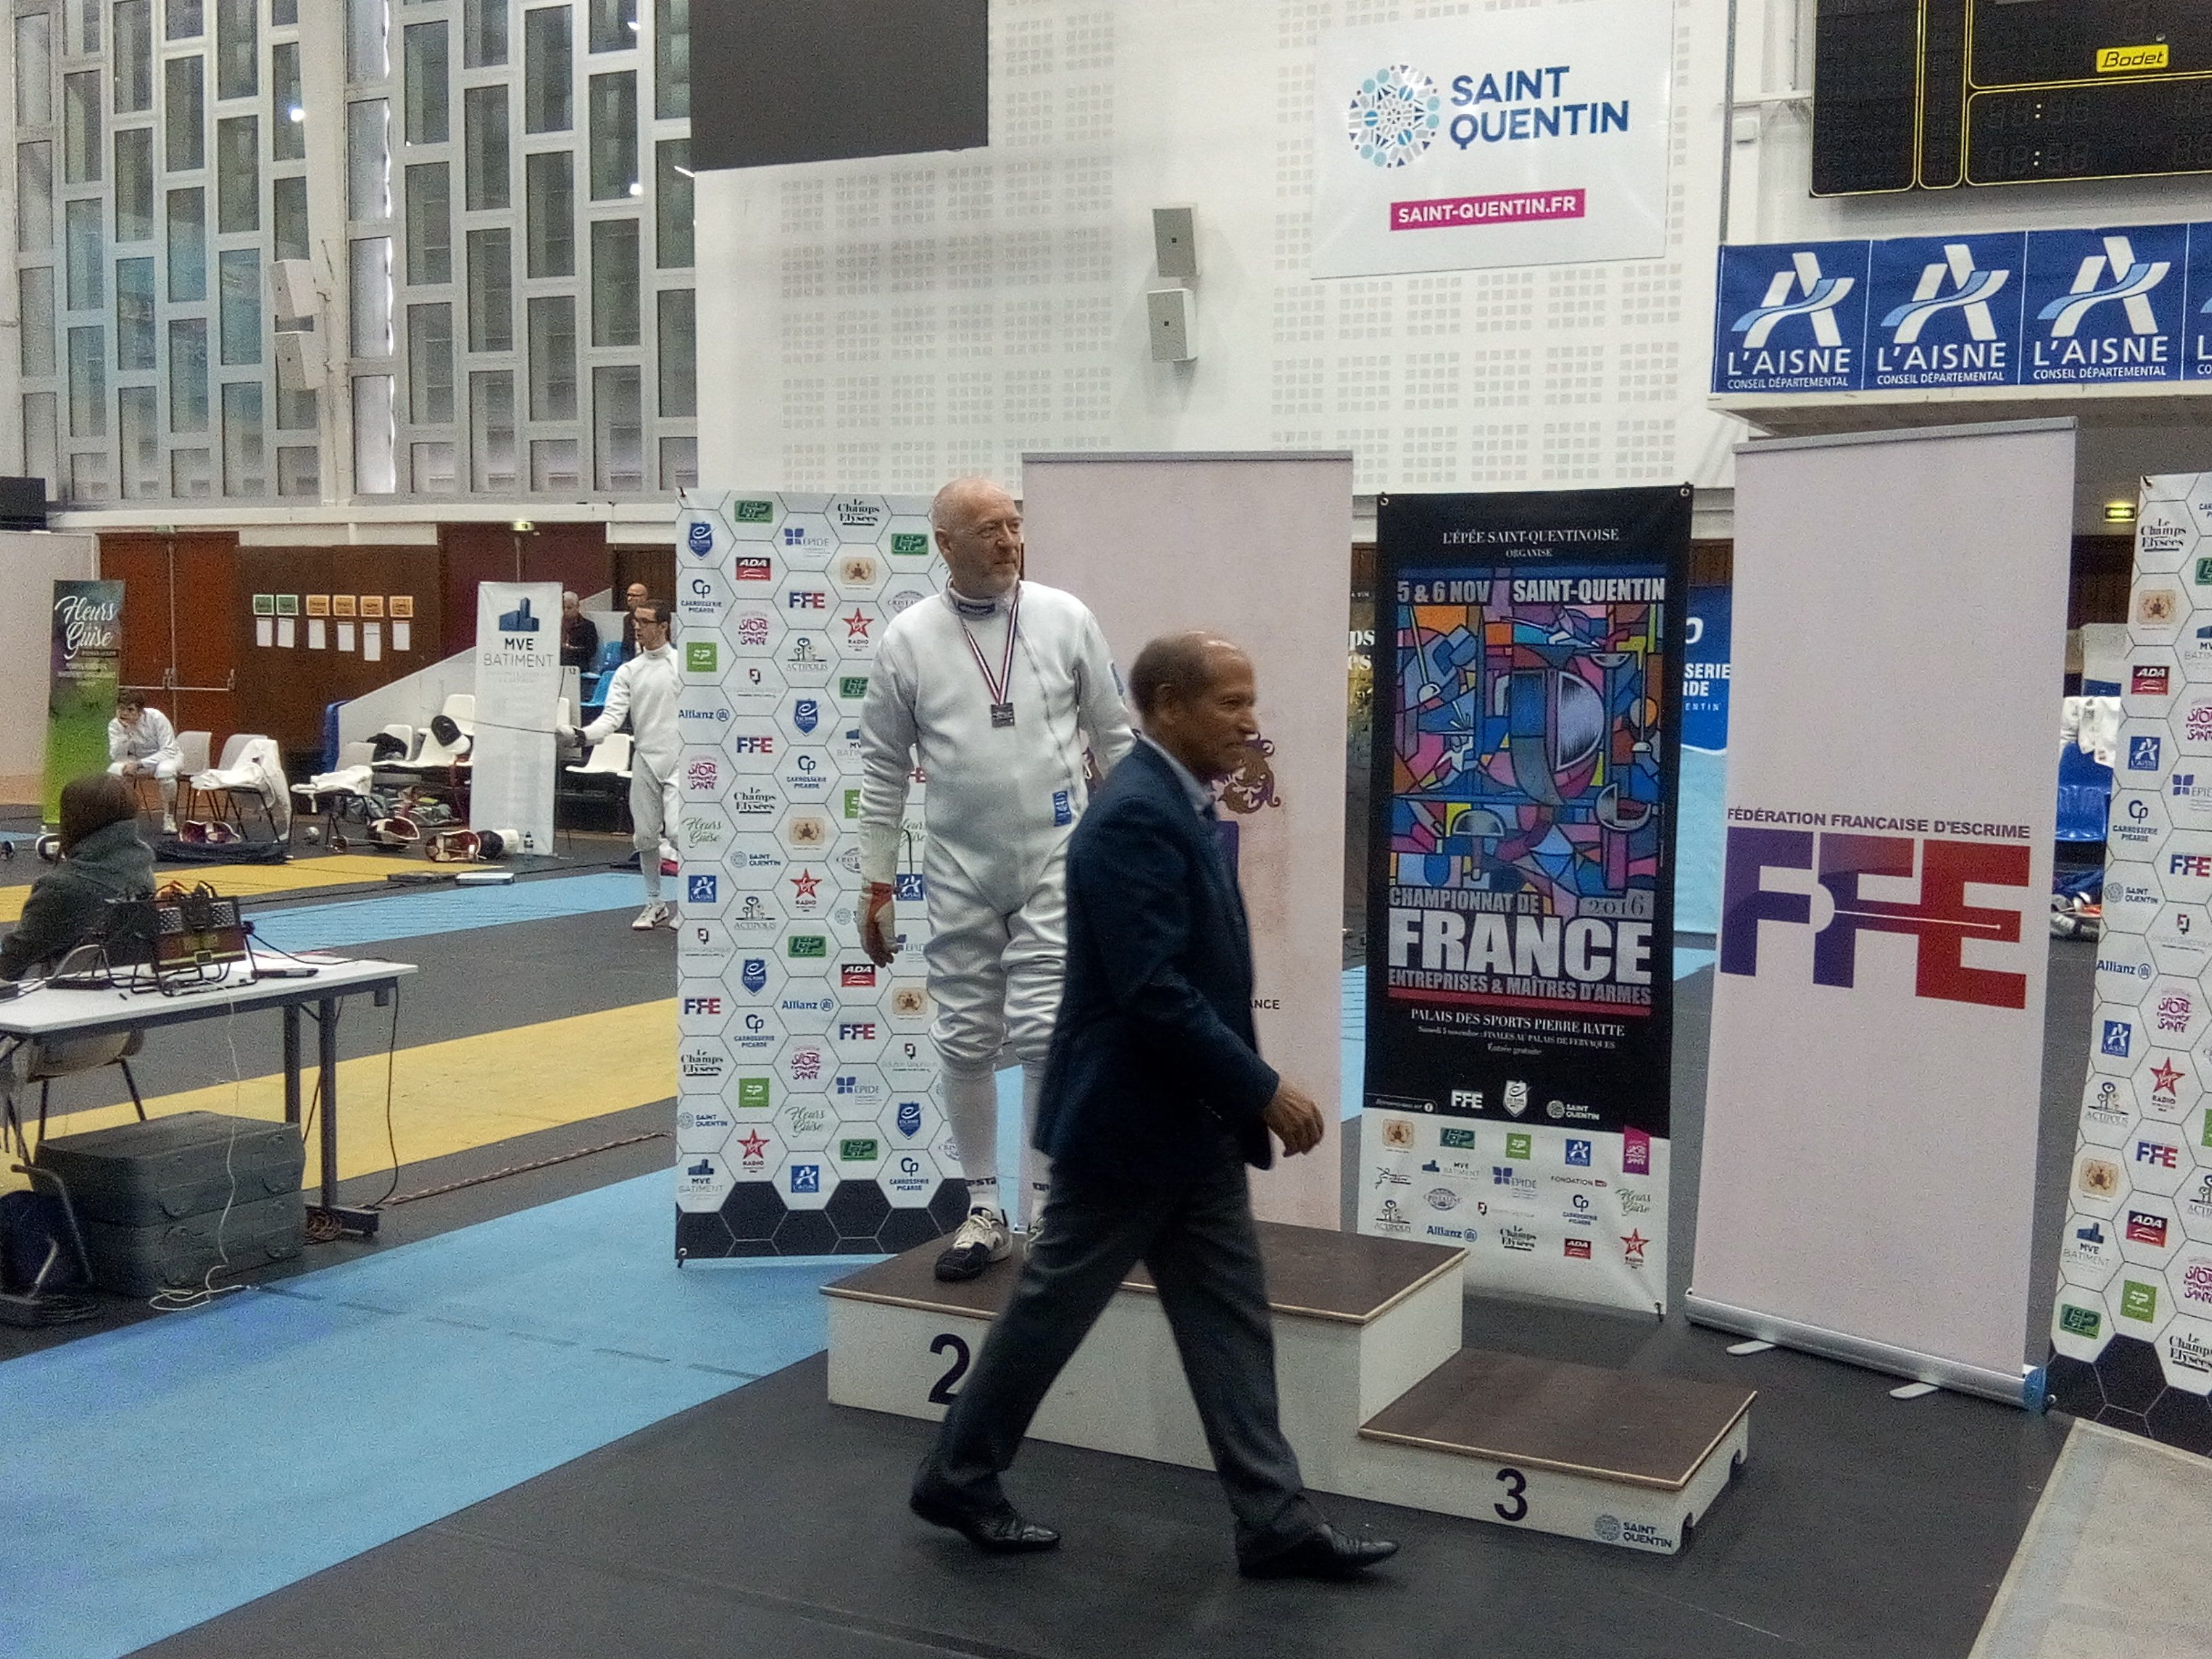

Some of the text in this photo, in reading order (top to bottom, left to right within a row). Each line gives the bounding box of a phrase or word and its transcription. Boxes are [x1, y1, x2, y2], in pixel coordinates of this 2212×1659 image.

[2102, 50, 2164, 68] Bodet
[1450, 66, 1570, 107] SAINT
[1450, 100, 1629, 150] QUENTIN
[1398, 195, 1576, 224] SAINT-QUENTIN.FR
[1877, 342, 2007, 371] L'AISNE
[2034, 336, 2168, 366] L'AISNE
[1728, 348, 1851, 375] L'AISNE
[1727, 375, 1848, 388] CONSEIL DÉPARTEMENTAL
[1877, 371, 2005, 385] CONSEIL DÉPARTEMENTAL
[2033, 366, 2167, 380] CONSEIL DÉPARTEMENTAL
[1488, 529, 1619, 545] SAINT-QUENTINOISE
[1506, 549, 1553, 558] ORGANISE
[739, 558, 767, 567] ADA
[1397, 579, 1410, 604] 5
[1433, 579, 1446, 603] 6
[1450, 579, 1490, 602] NOV
[1513, 578, 1666, 603] SAINT-QUENTIN
[789, 592, 825, 609] FFE
[504, 638, 534, 651] MVE
[1684, 663, 1731, 680] SERIE
[2137, 668, 2165, 677] ADA
[678, 710, 714, 720] Allianz
[737, 737, 773, 753] FFE
[734, 792, 776, 802] Champs
[1727, 806, 2030, 839] FÉDÉRATION FRANÇAISE D'ESCRIME
[2169, 854, 2212, 877] FFE
[1389, 886, 1539, 914] CHAMPIONNAT DE
[1589, 894, 1644, 916] 2016
[1720, 826, 2030, 1010] FFE
[1388, 907, 1653, 985] FRANCE
[844, 966, 872, 974] ADA
[2095, 960, 2137, 975] Allianz
[1389, 968, 1488, 994] ENTREPRISES
[1506, 975, 1576, 1000] MAÎTRES
[1579, 983, 1652, 1006] D'ARMES
[684, 998, 721, 1015] FFE
[781, 1000, 817, 1009] Allianz
[1411, 1008, 1452, 1023] PALAIS
[1456, 1011, 1480, 1025] DES
[1483, 1013, 1531, 1029] SPORTS
[1534, 1018, 1580, 1034] PIERRE
[839, 1023, 875, 1040] FFE
[681, 1054, 723, 1065] Champs
[1451, 1089, 1483, 1109] FFE
[1565, 1103, 1589, 1113] SAINT
[1565, 1111, 1600, 1120] QUENTIN
[2135, 1141, 2179, 1169] FFE
[2132, 1212, 2163, 1229] ADA
[1427, 1225, 1463, 1239] Allianz
[1567, 1240, 1589, 1248] ADA
[2080, 1243, 2100, 1254] MVE
[928, 1333, 970, 1406] 2
[1494, 1468, 1528, 1522] 3
[1622, 1521, 1656, 1535] SAINT
[1622, 1531, 1673, 1549] QUENTIN
